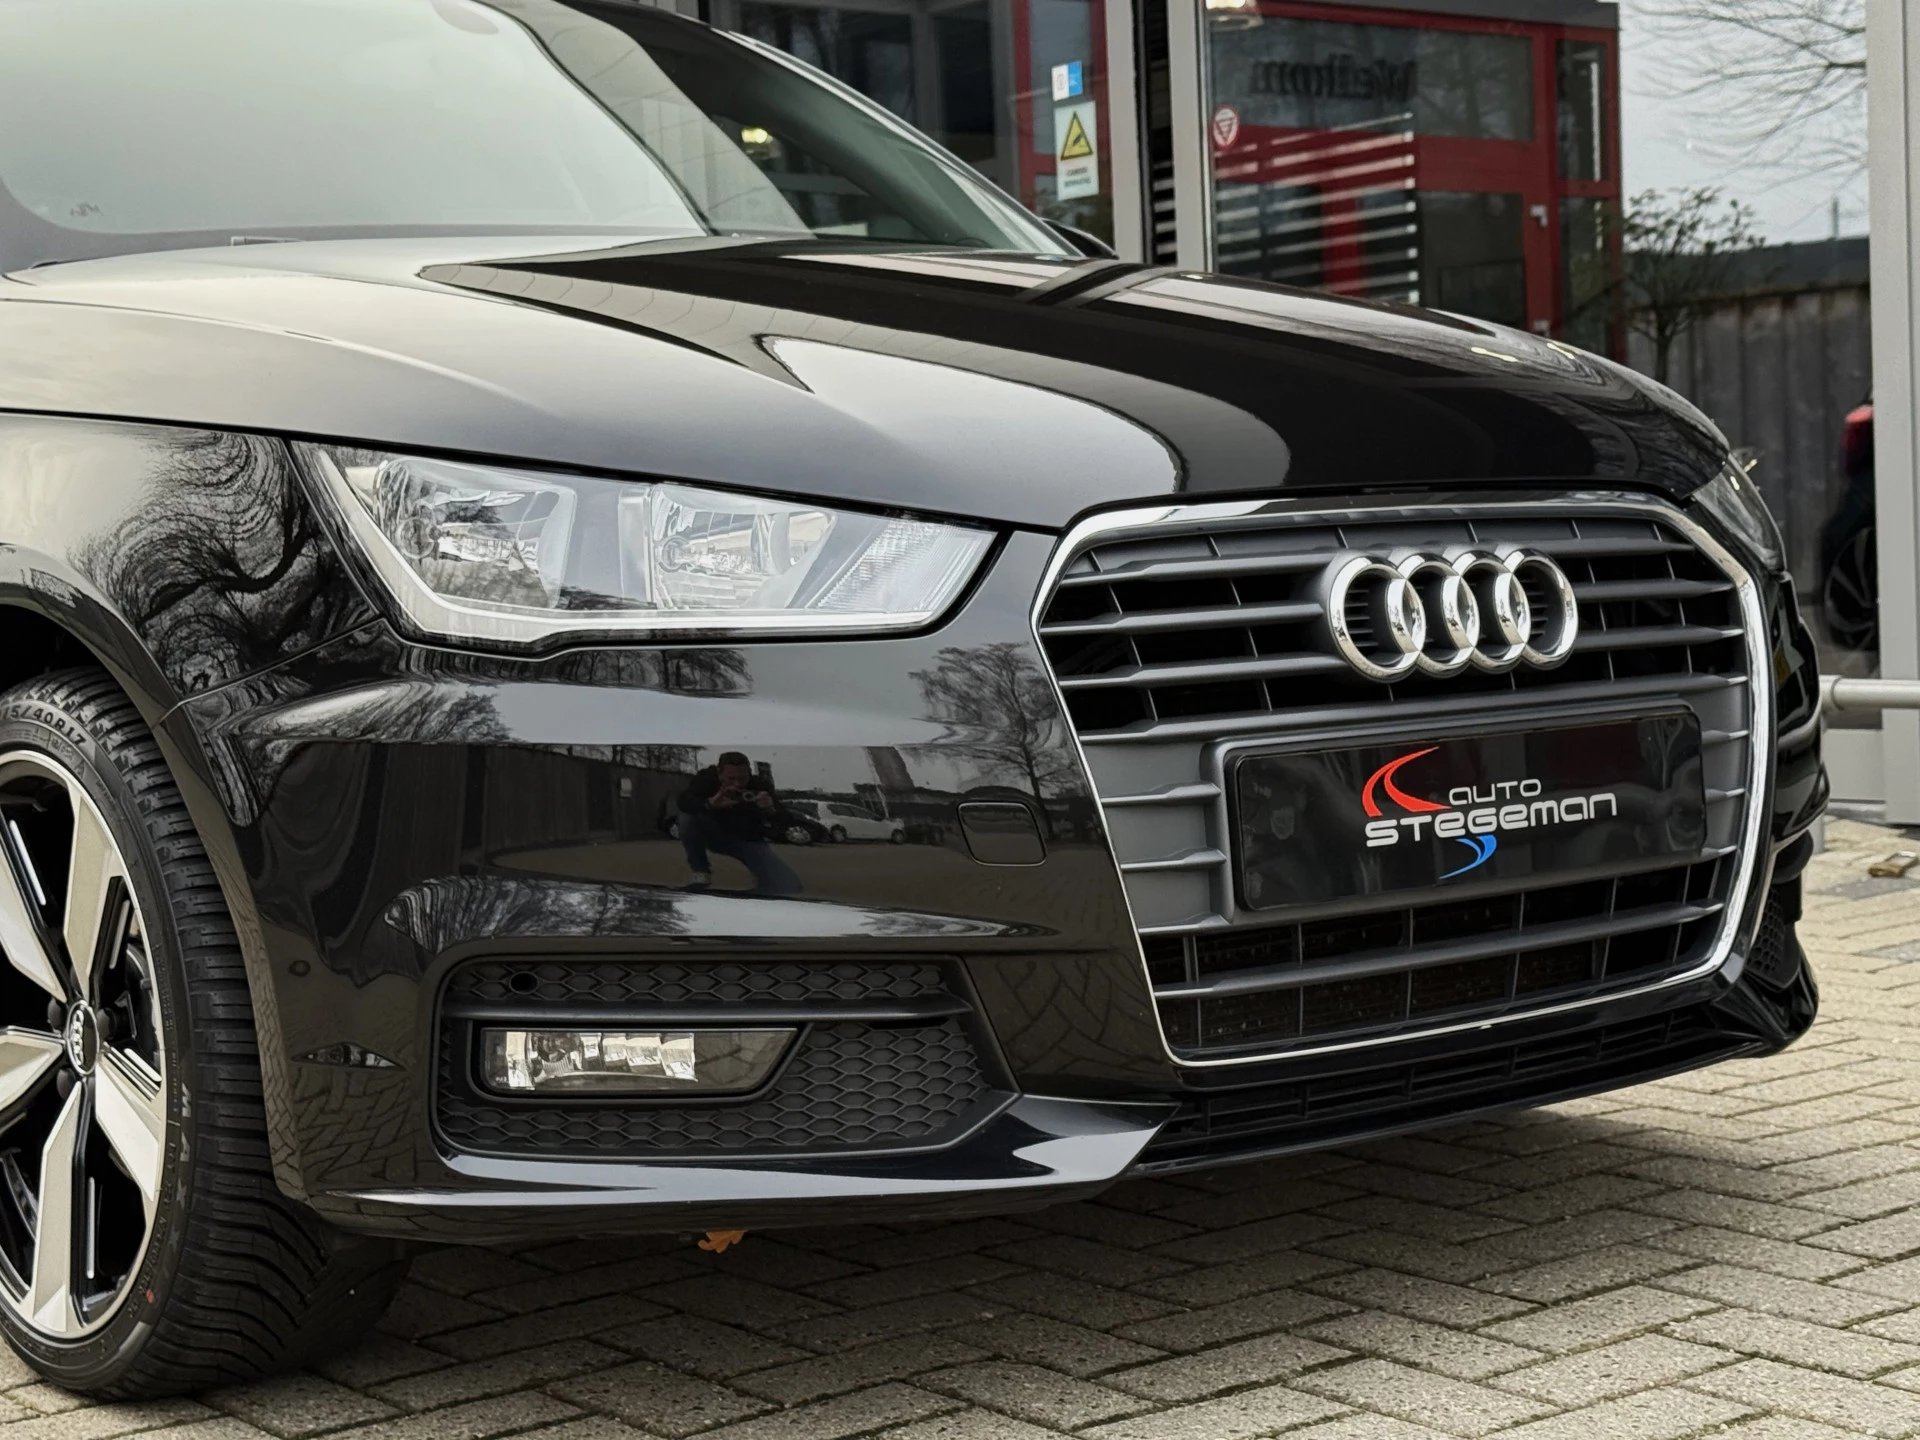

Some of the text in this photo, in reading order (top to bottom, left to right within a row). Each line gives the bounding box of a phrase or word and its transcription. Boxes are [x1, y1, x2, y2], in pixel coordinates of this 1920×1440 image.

[0, 705, 87, 747] 15/40R17
[1448, 778, 1542, 806] AUTO
[1364, 792, 1618, 848] STEGEMAN
